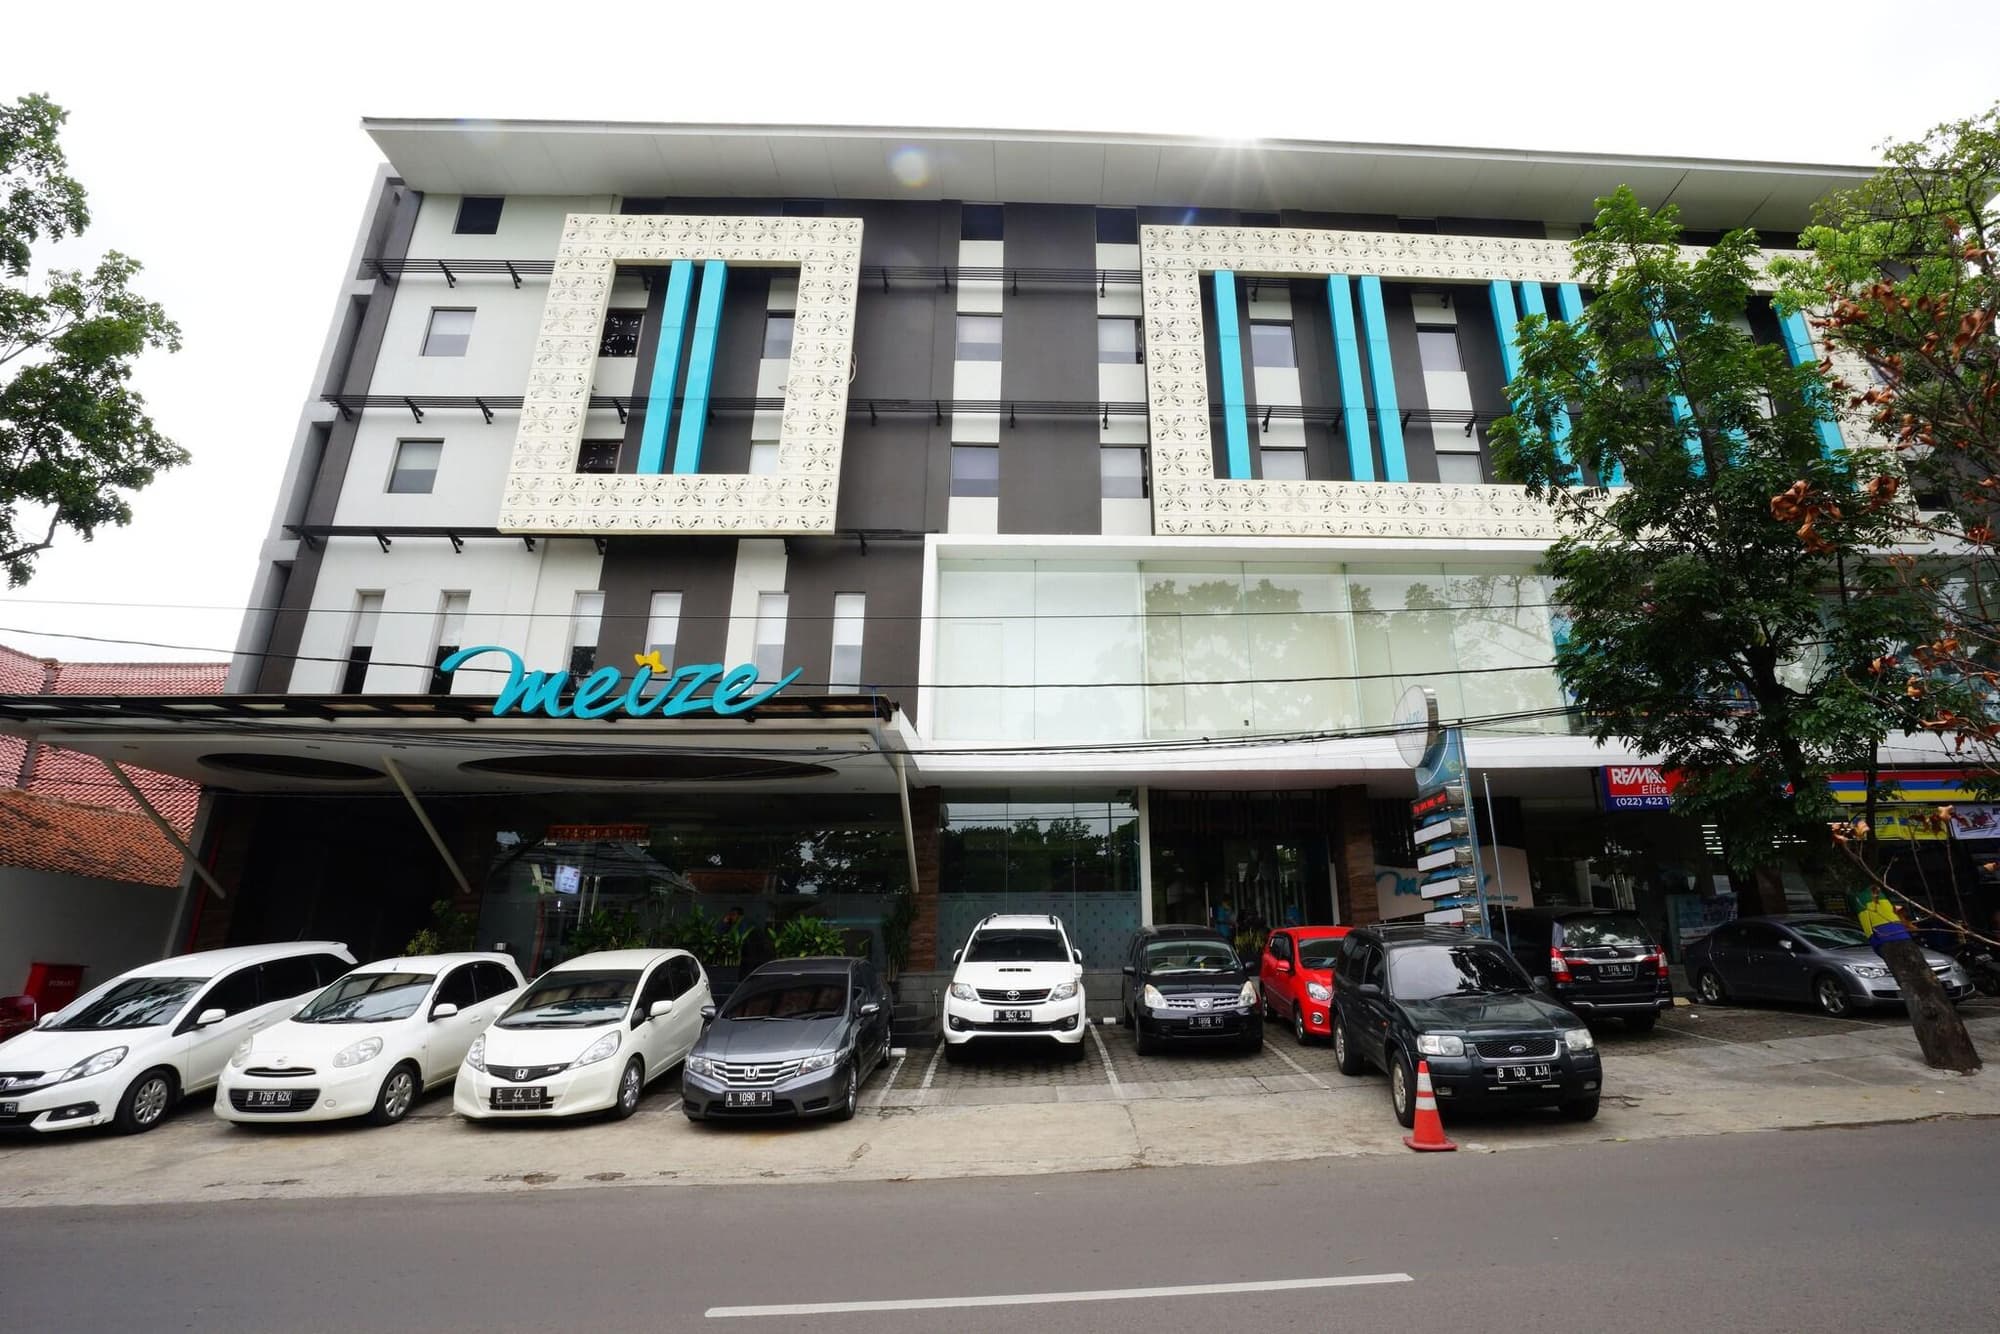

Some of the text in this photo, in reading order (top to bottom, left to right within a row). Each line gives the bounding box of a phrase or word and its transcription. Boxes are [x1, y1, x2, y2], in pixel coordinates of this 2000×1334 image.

[1641, 785, 1668, 795] Elite
[1616, 798, 1642, 807] (022)
[1645, 797, 1664, 806] 422
[1499, 1068, 1504, 1078] B
[1513, 1066, 1527, 1077] 100
[727, 1092, 733, 1102] A
